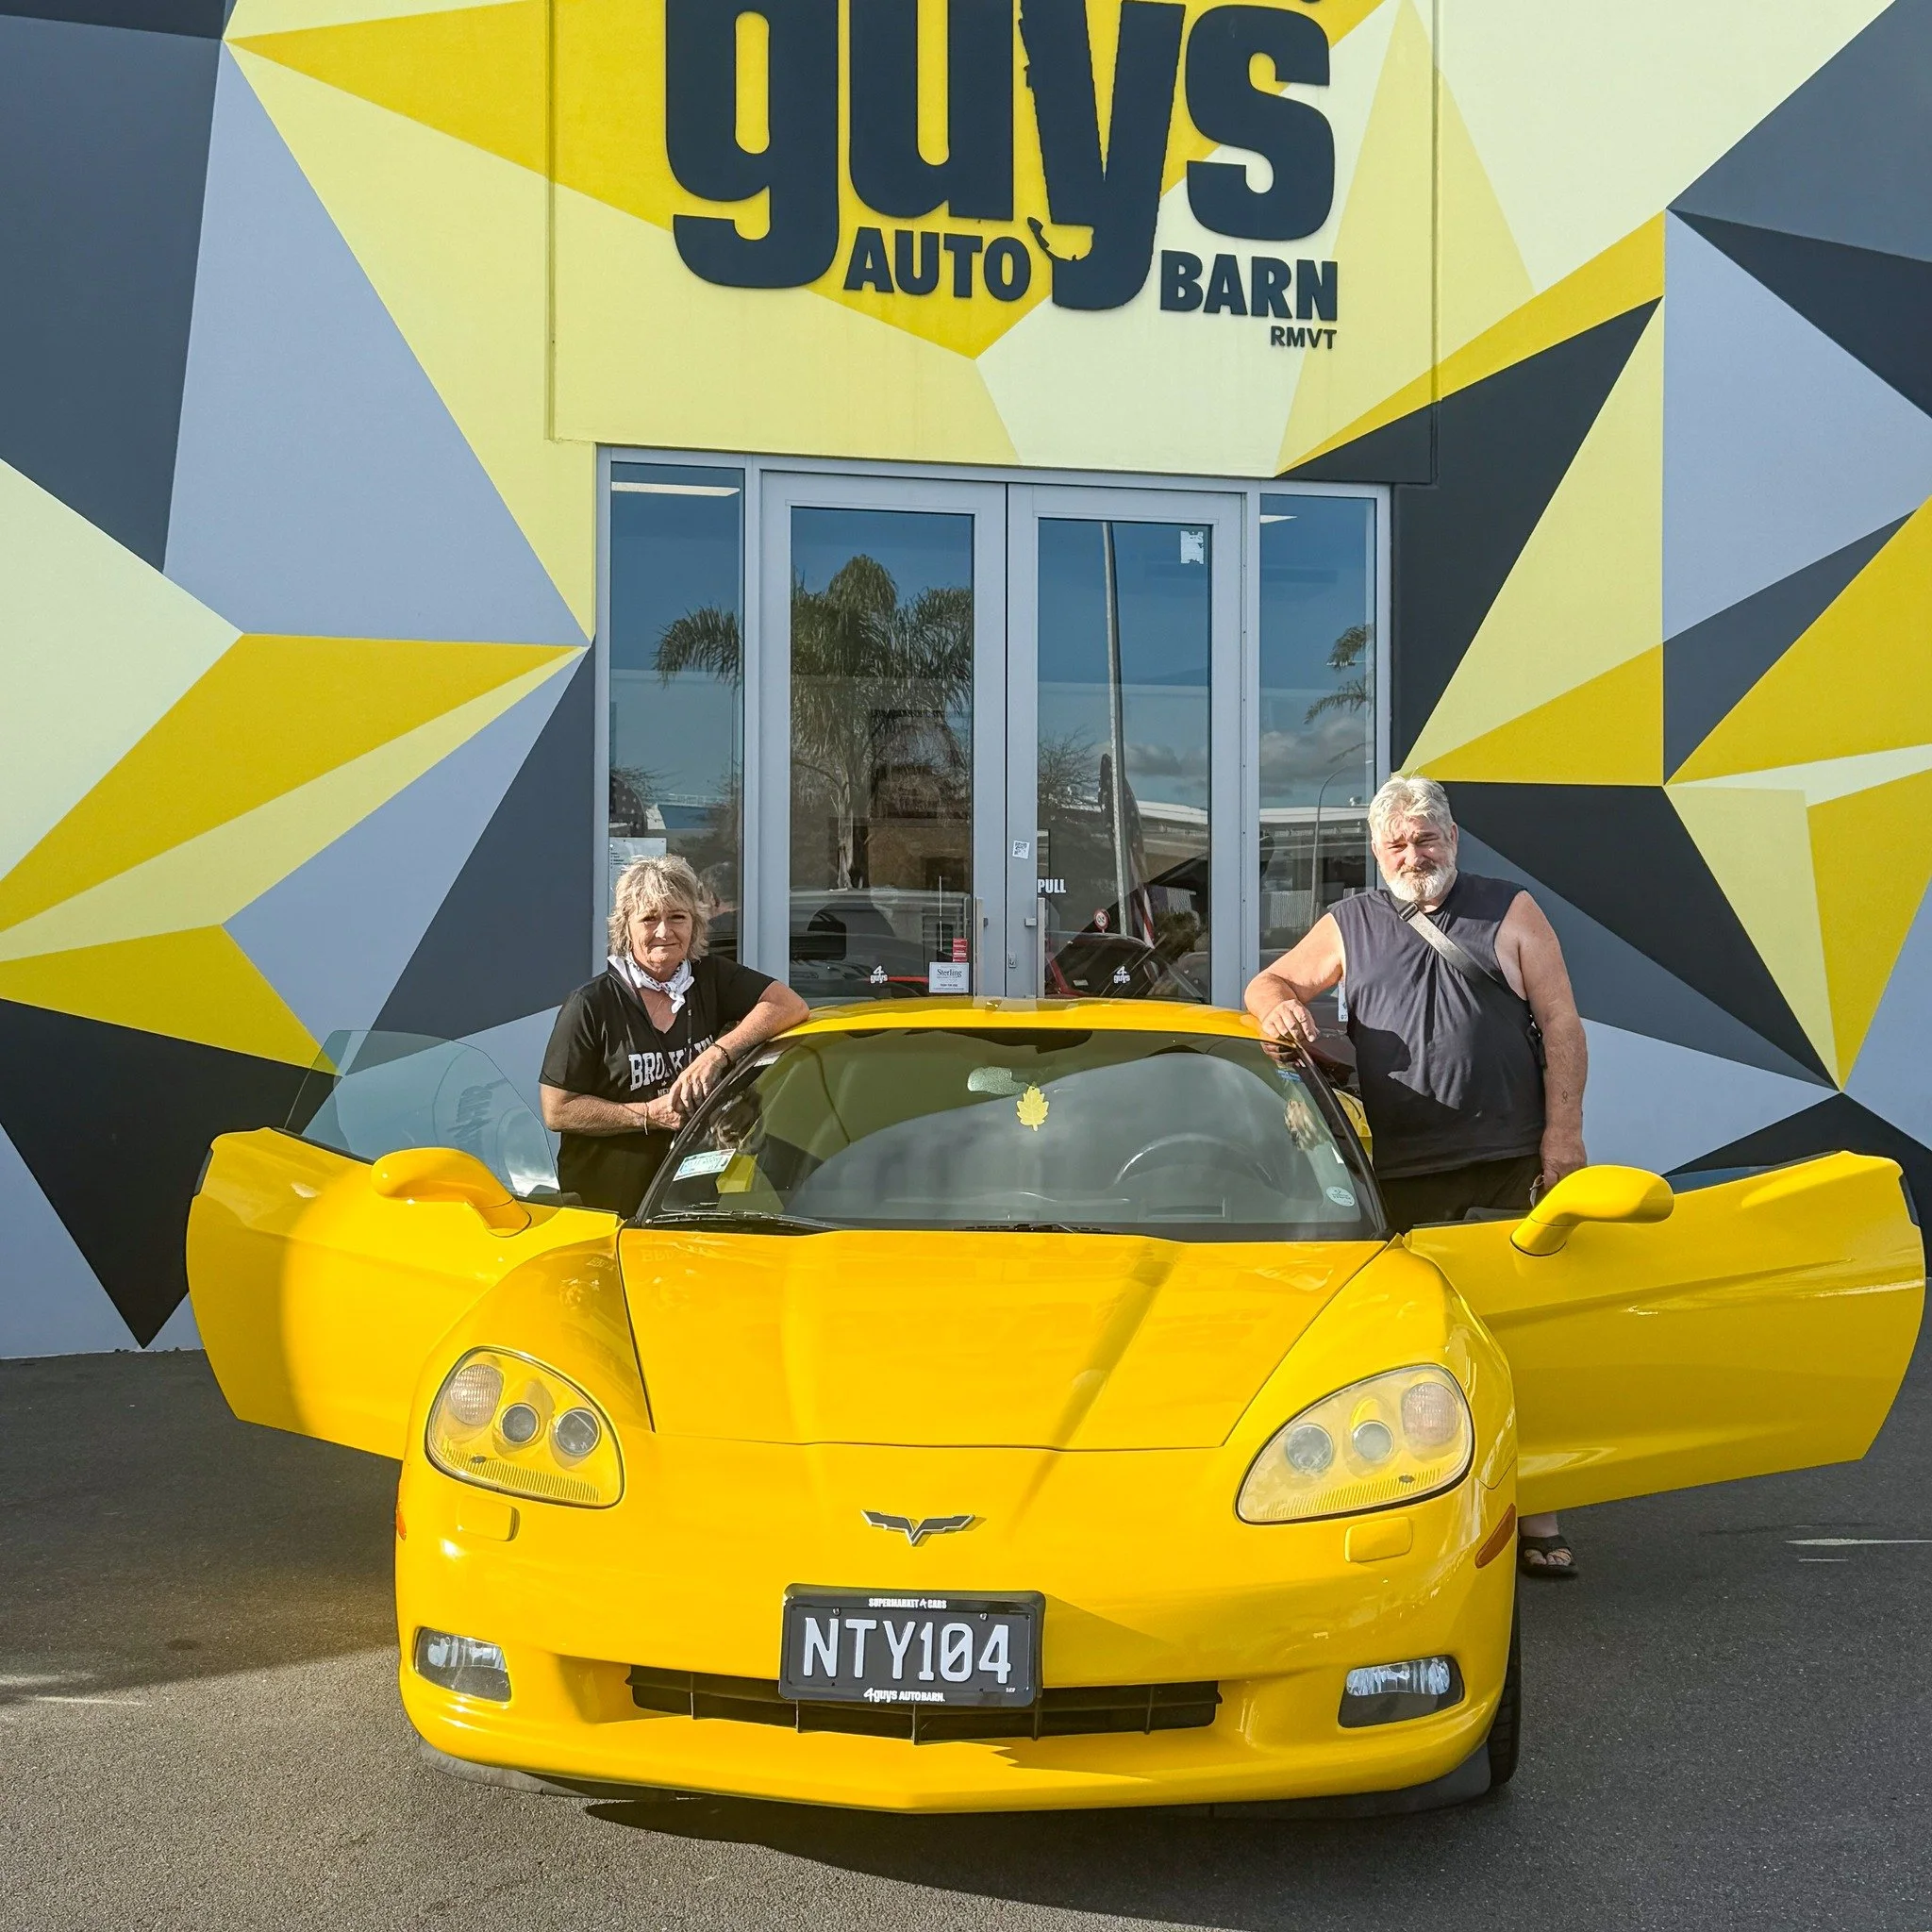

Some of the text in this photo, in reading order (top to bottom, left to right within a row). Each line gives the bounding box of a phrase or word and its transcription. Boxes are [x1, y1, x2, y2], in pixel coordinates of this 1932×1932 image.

[665, 0, 1336, 311] guys
[843, 226, 1339, 322] AUTO BARN
[1270, 325, 1337, 350] RMVT
[1037, 878, 1067, 893] PULL
[873, 965, 885, 976] 4
[937, 969, 962, 978] Sterling
[870, 974, 888, 984] guys
[1113, 974, 1130, 984] guys
[868, 1598, 920, 1608] SUPERMARKET
[927, 1599, 947, 1609] CARS
[803, 1617, 1012, 1684] NTY104
